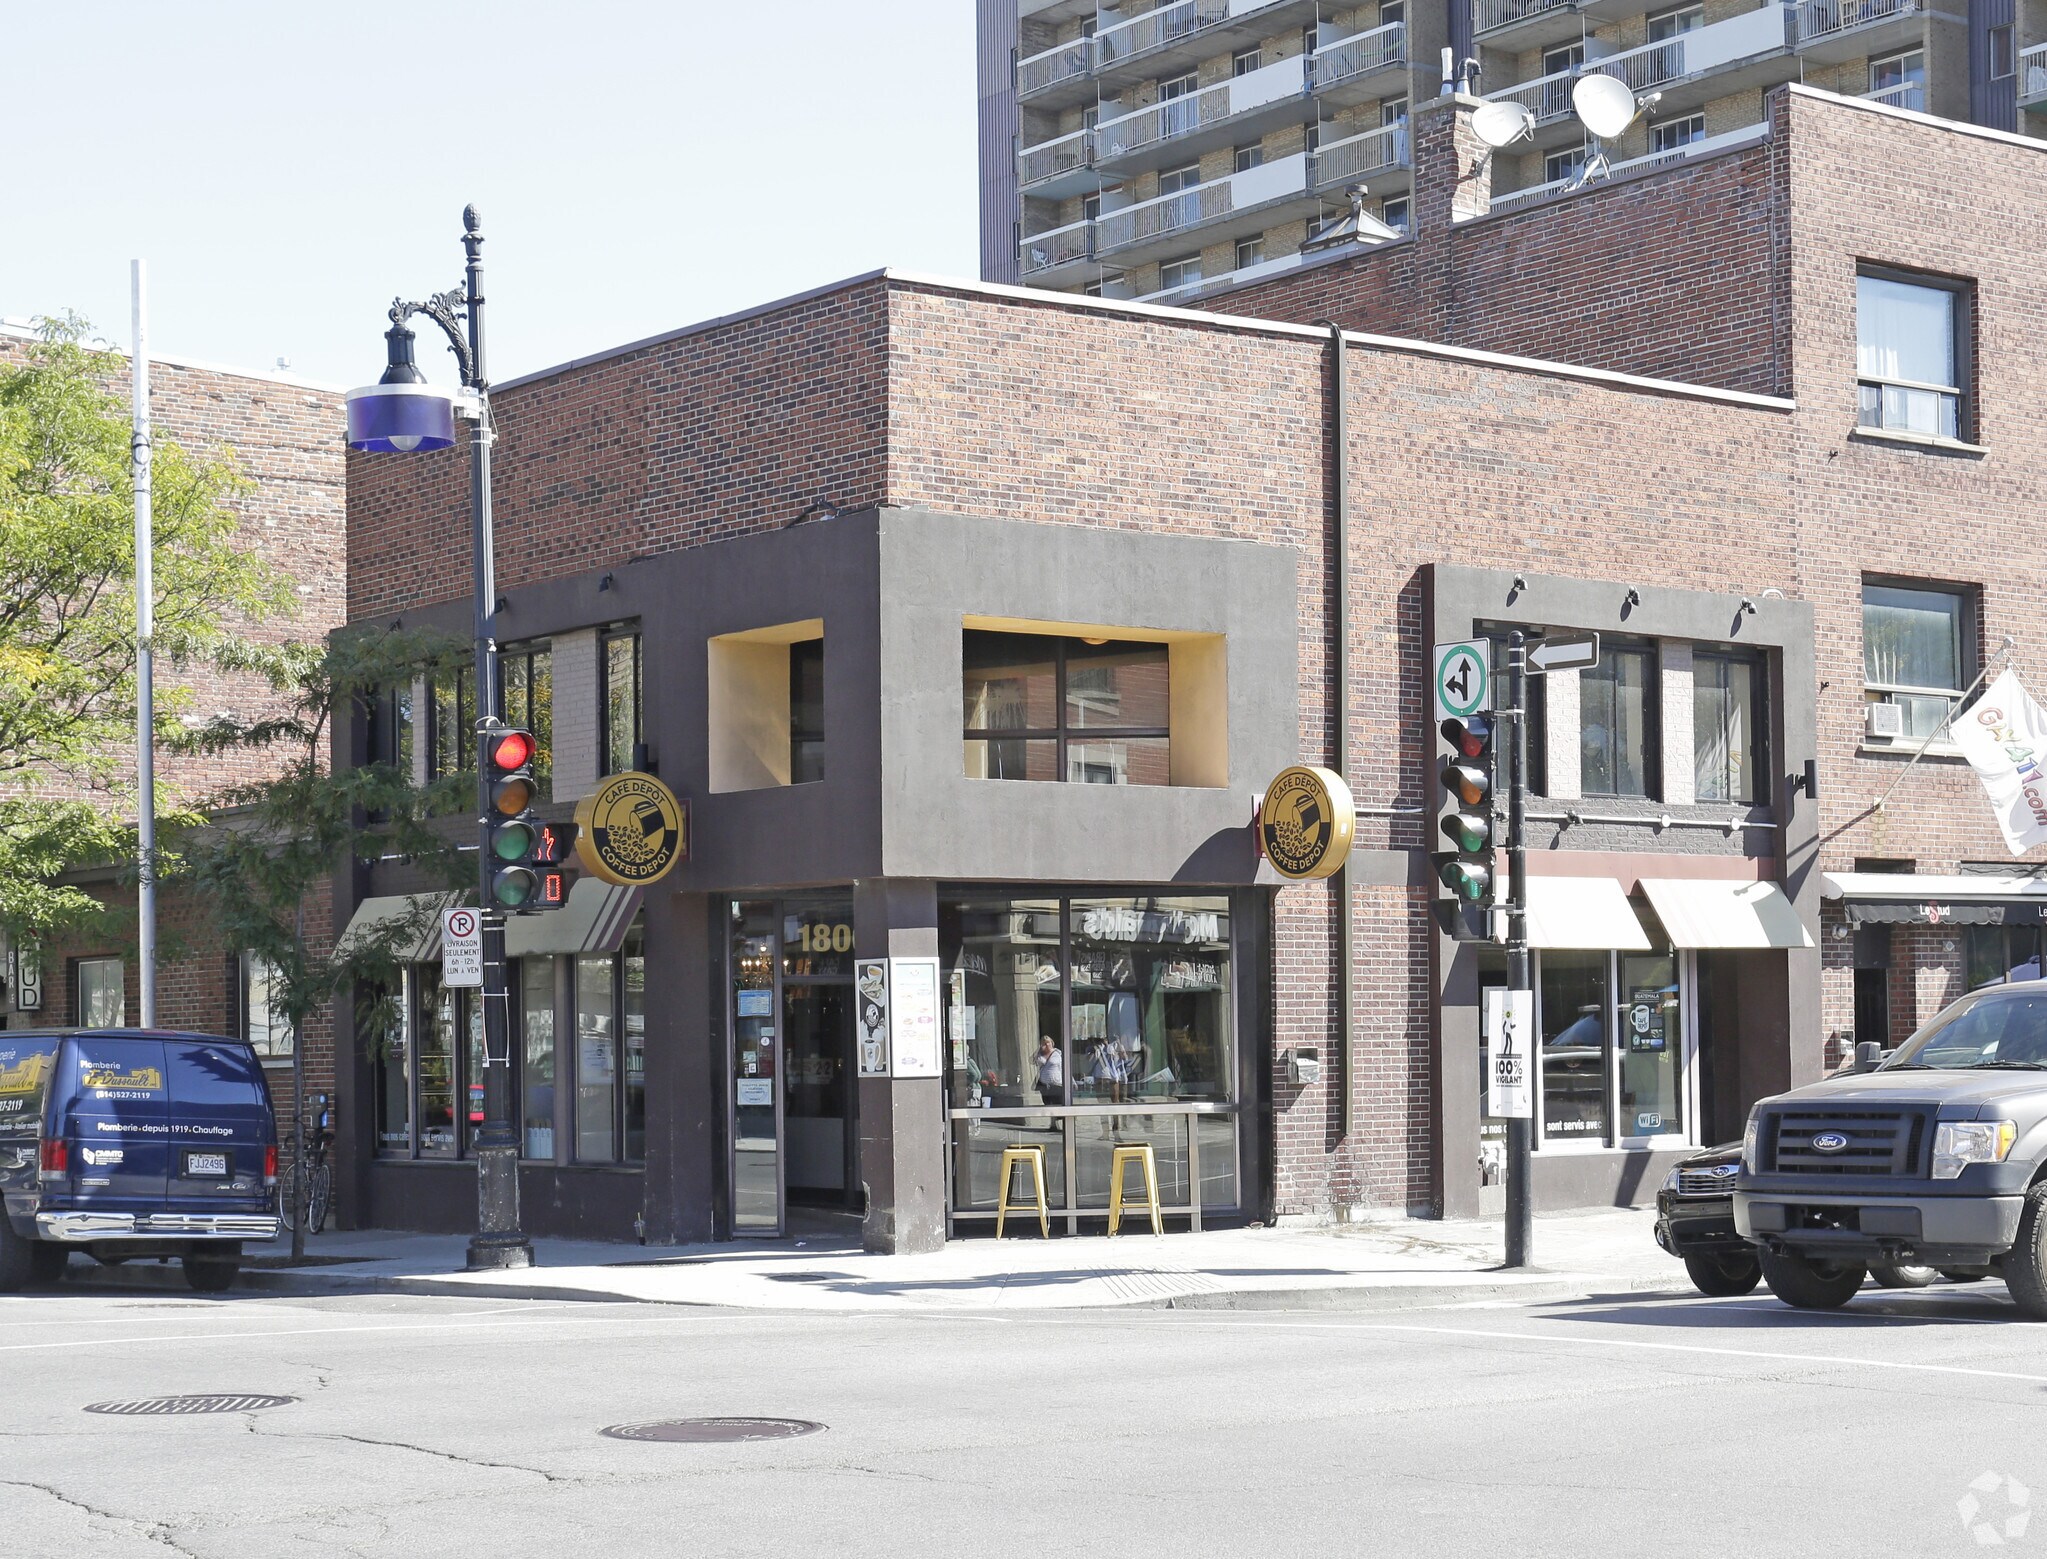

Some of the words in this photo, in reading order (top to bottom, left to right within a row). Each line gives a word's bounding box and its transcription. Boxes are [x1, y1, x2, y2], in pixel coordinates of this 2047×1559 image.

[605, 780, 630, 804] CAFÉ
[632, 781, 666, 805] DÉPÔT
[1273, 776, 1293, 800] CAFÉ
[1294, 776, 1321, 797] DÉPÔT
[602, 846, 638, 876] COFFEE
[639, 846, 670, 876] DEPOT
[1270, 842, 1298, 870] COFFEE
[1299, 840, 1325, 870] DEPOT
[446, 940, 478, 948] LIVRAISON
[797, 923, 855, 953] 180
[445, 948, 480, 957] SEULEMENT
[451, 958, 459, 966] 6h
[464, 957, 475, 965] 12h
[446, 967, 459, 975] LUN
[466, 966, 479, 974] VEN
[80, 1059, 121, 1070] Plomberie
[1495, 1060, 1523, 1075] 100%
[100, 1070, 150, 1087] Dussault
[1495, 1075, 1523, 1085] VIGILANT
[97, 1122, 138, 1132] Plomberie
[142, 1124, 169, 1134] depuis
[171, 1124, 189, 1133] 1919
[192, 1125, 234, 1137] Chauffage
[1546, 1120, 1562, 1131] sont
[1563, 1119, 1585, 1131] servis
[1585, 1121, 1603, 1130] avec
[1818, 1136, 1839, 1147] Ford
[189, 1158, 224, 1170] FJJ2496
